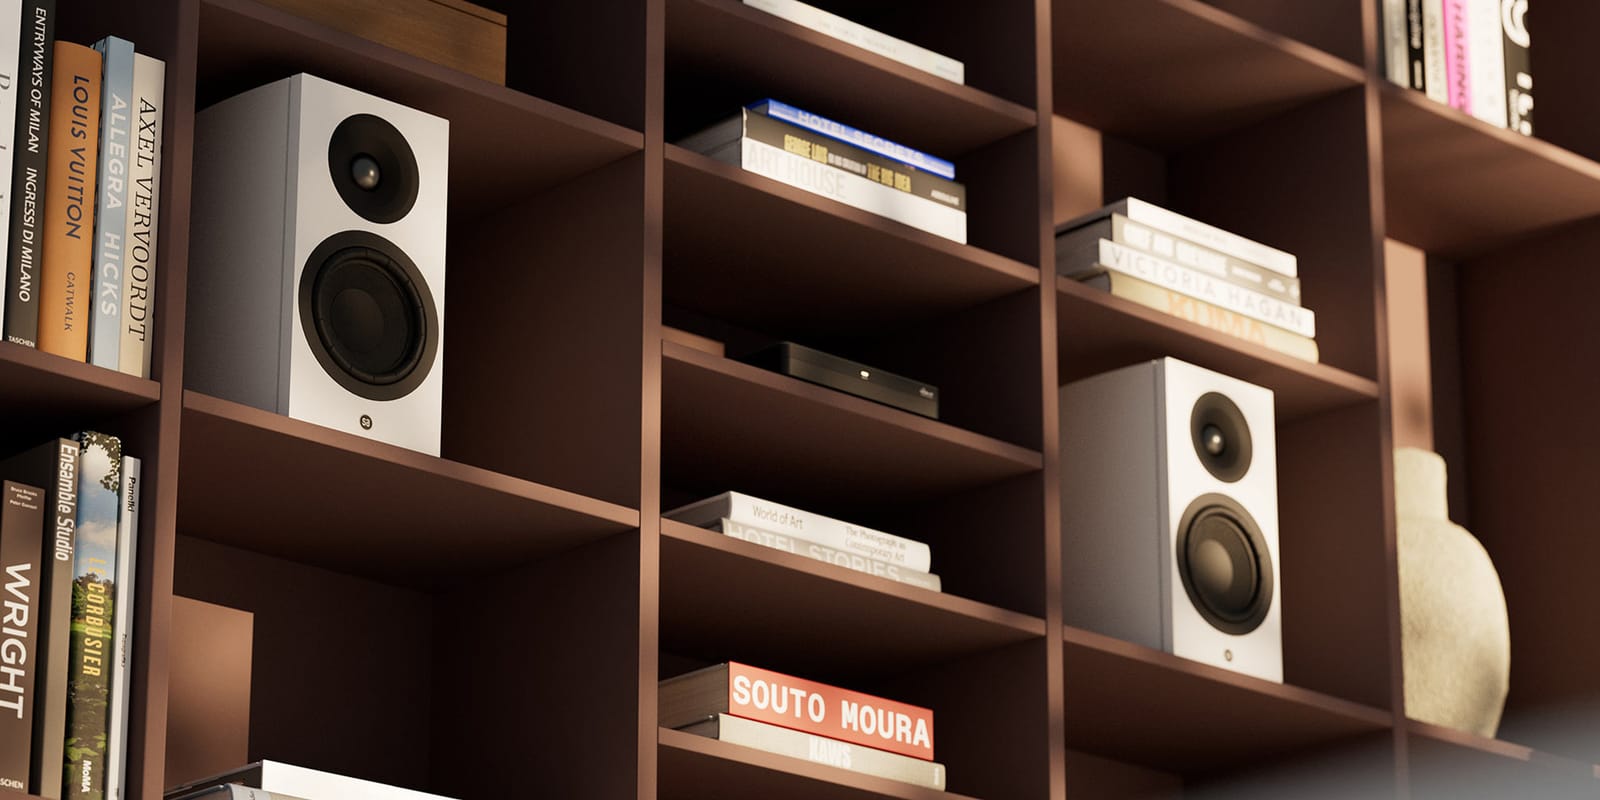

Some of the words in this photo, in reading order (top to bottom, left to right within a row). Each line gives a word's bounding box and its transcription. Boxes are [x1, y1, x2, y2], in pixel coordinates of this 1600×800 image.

[32, 7, 47, 88] ENTRYWAYS
[30, 89, 43, 108] OF
[72, 74, 90, 140] LOUIS
[28, 107, 41, 153] MILAN
[106, 93, 128, 210] ALLEGRA
[137, 97, 157, 169] AXEL
[24, 167, 38, 228] INGRESSI
[65, 147, 86, 241] VUITTON
[786, 155, 848, 198] HOUSE
[22, 230, 34, 245] DI
[128, 175, 154, 342] VERVOORDT
[18, 246, 33, 303] MILANO
[63, 271, 76, 332] CATWALK
[101, 231, 121, 318] HICKS
[1111, 245, 1216, 299] VICTORIA
[1228, 289, 1303, 328] HAGAN
[8, 335, 35, 348] TASCHEN
[58, 443, 79, 514] Ensamble
[127, 476, 137, 512] Panelki
[55, 516, 75, 562] Studio
[752, 504, 779, 526] World
[780, 513, 790, 525] of
[789, 514, 804, 530] Art
[87, 557, 107, 576] LE
[0, 563, 32, 720] WRIGHT
[83, 582, 106, 677] CORBUSIER
[732, 675, 826, 723] SOUTO
[841, 700, 931, 749] MOURA
[81, 760, 92, 793] MoMA
